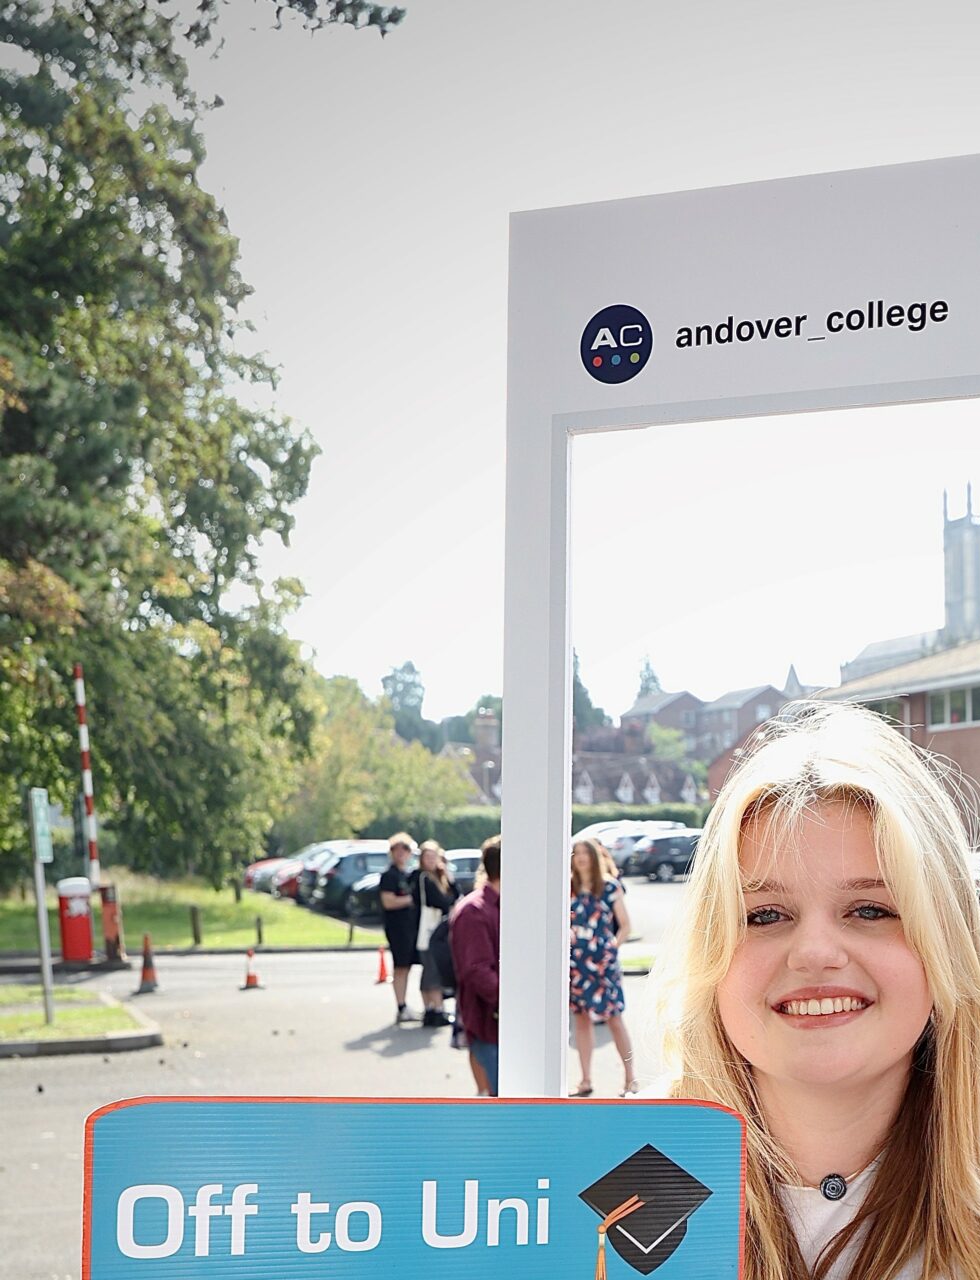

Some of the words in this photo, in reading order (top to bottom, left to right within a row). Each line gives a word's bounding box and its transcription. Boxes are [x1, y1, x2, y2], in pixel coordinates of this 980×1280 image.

[590, 325, 643, 350] AC
[675, 299, 949, 348] andover_college
[116, 1183, 259, 1259] Off
[291, 1192, 382, 1253] to
[421, 1178, 550, 1248] Uni
